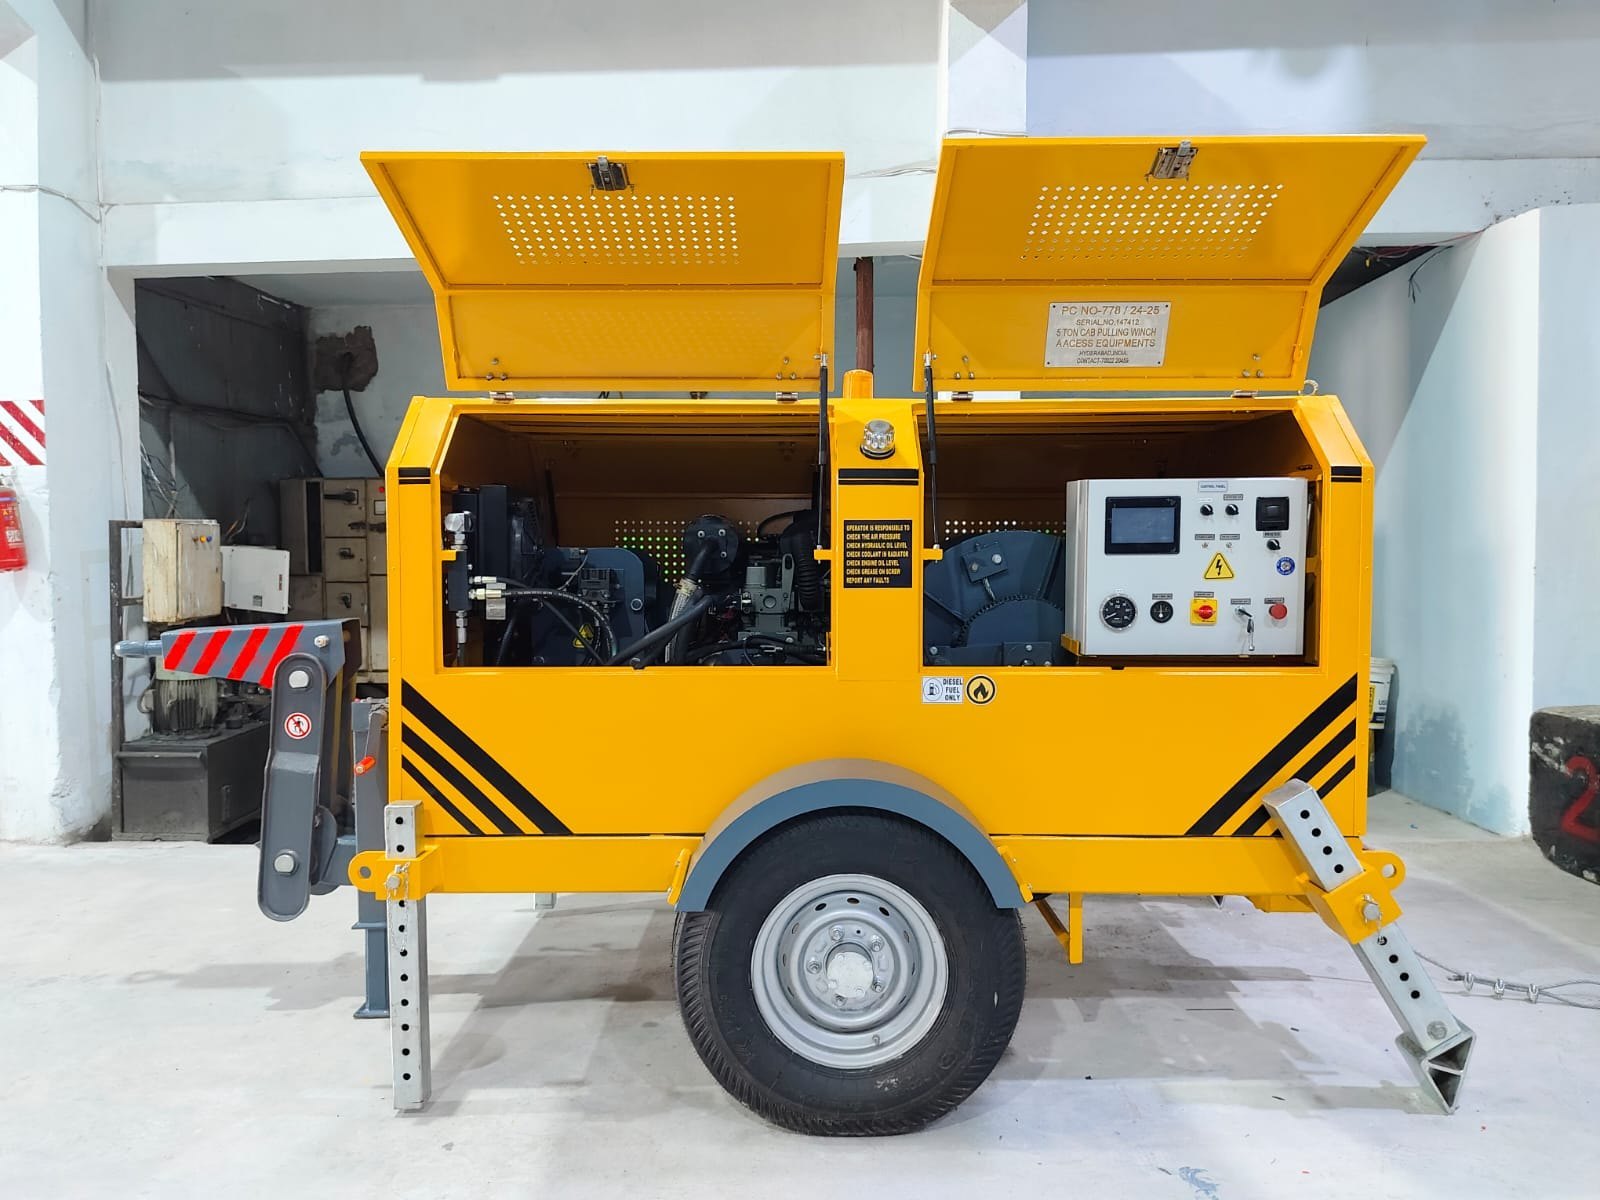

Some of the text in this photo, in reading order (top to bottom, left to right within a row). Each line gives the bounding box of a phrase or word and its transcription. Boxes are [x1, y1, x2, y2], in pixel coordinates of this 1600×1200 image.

[1061, 305, 1077, 315] PC
[1080, 305, 1121, 315] NO-778
[1130, 305, 1160, 315] 24-25
[1056, 328, 1157, 337] 5 TON CAB PULLING WINCH
[1096, 339, 1156, 348] EQUIPMENTS
[1560, 755, 1600, 843] 2
